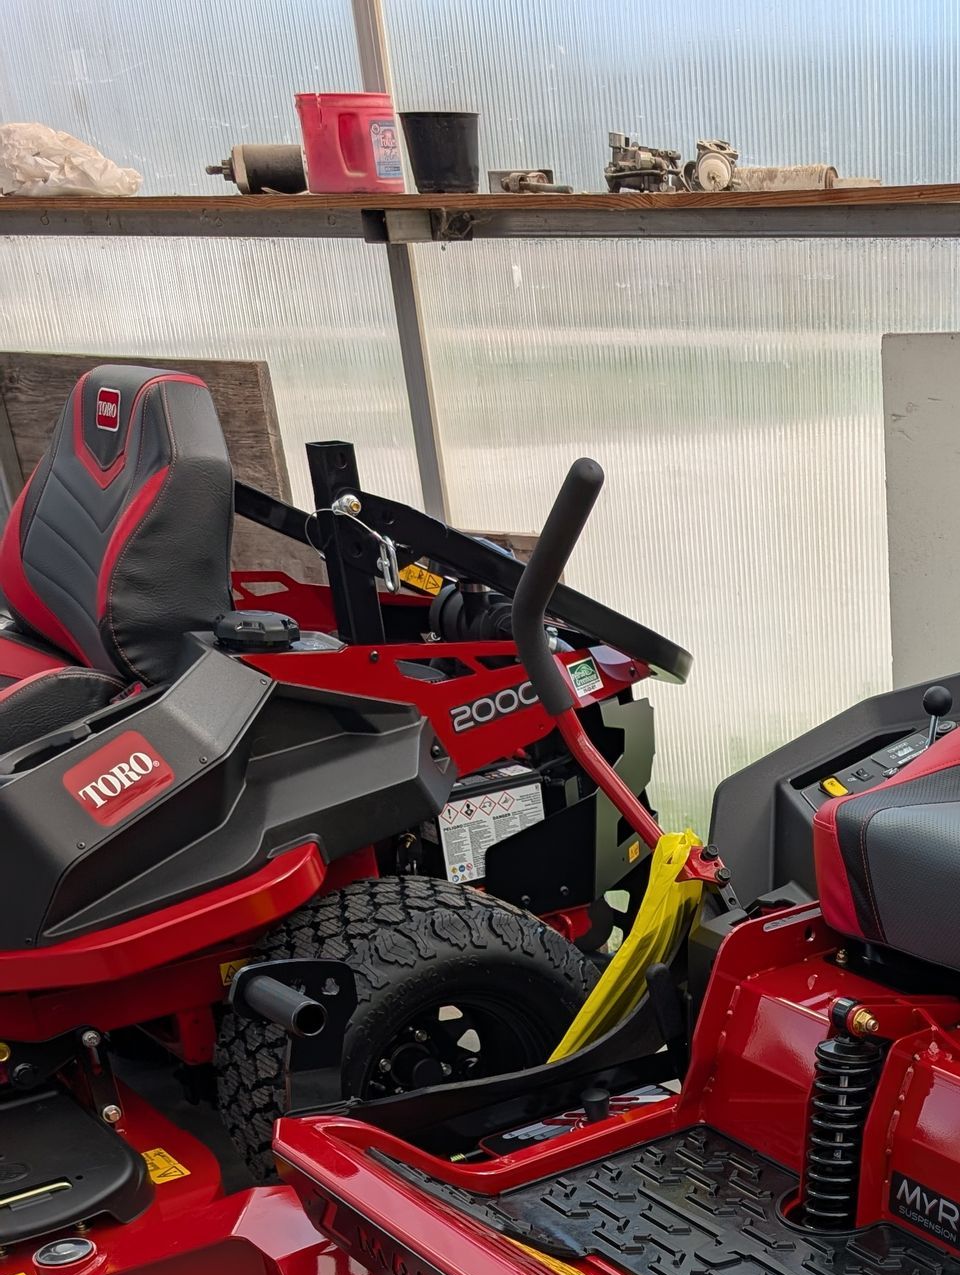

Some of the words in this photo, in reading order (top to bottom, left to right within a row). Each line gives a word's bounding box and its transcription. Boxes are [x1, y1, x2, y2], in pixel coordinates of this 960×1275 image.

[98, 400, 117, 418] TORO
[78, 752, 154, 809] TORO
[898, 1204, 957, 1243] SUSPENSION
